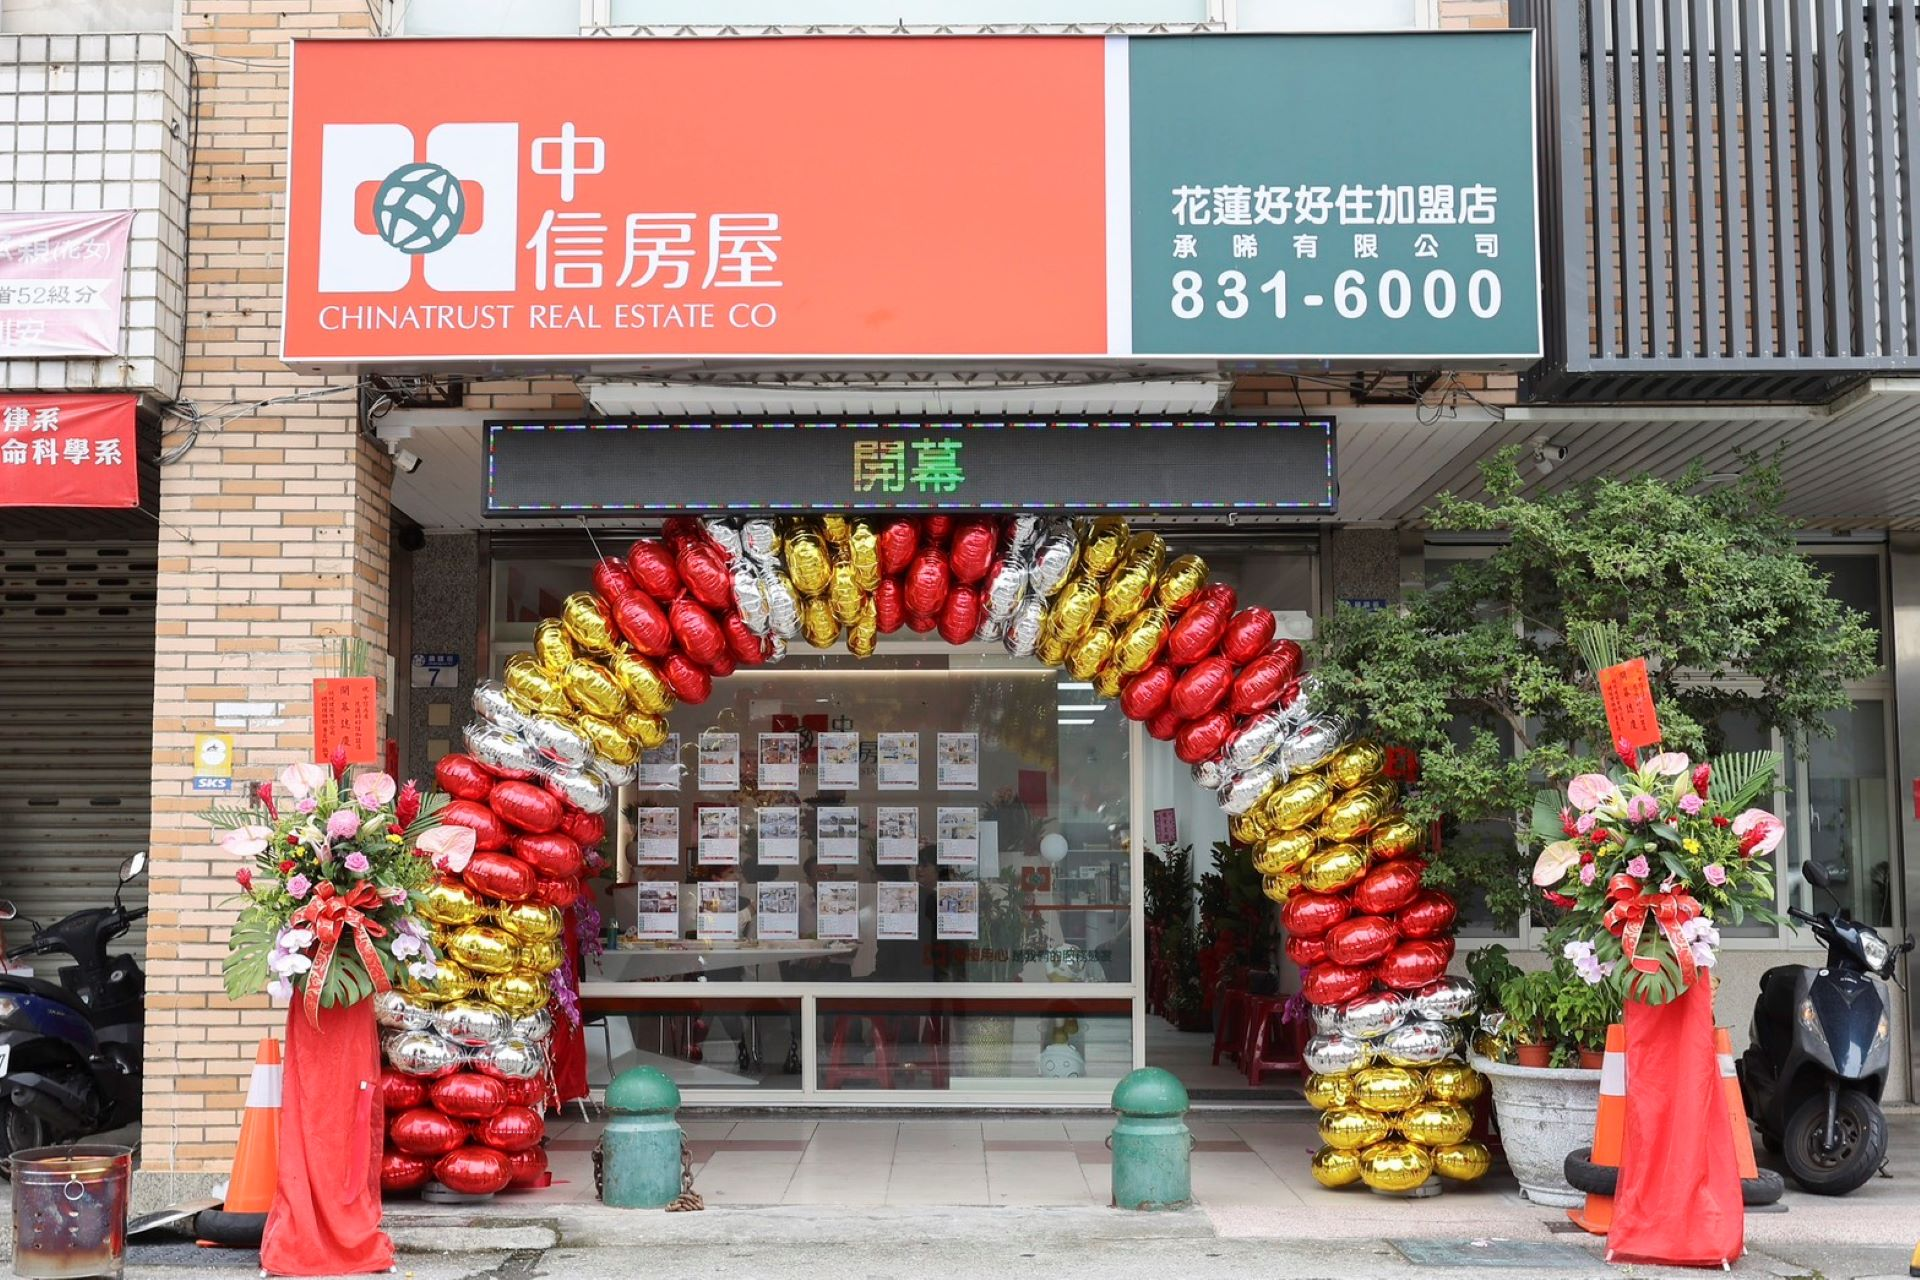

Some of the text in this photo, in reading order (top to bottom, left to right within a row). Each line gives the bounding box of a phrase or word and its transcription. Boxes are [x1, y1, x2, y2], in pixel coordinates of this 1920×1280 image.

[531, 121, 605, 203] 中
[1171, 183, 1498, 226] 花蓮好好住加盟店
[525, 209, 783, 291] 信房屋
[1170, 269, 1502, 319] 831-6000
[318, 303, 777, 331] CHINATRUST REAL ESTATE CO
[3, 407, 60, 432] 律系
[1, 438, 122, 465] 命科學系
[854, 438, 965, 492] 開幕
[428, 668, 440, 687] 7
[198, 778, 226, 788] SKS
